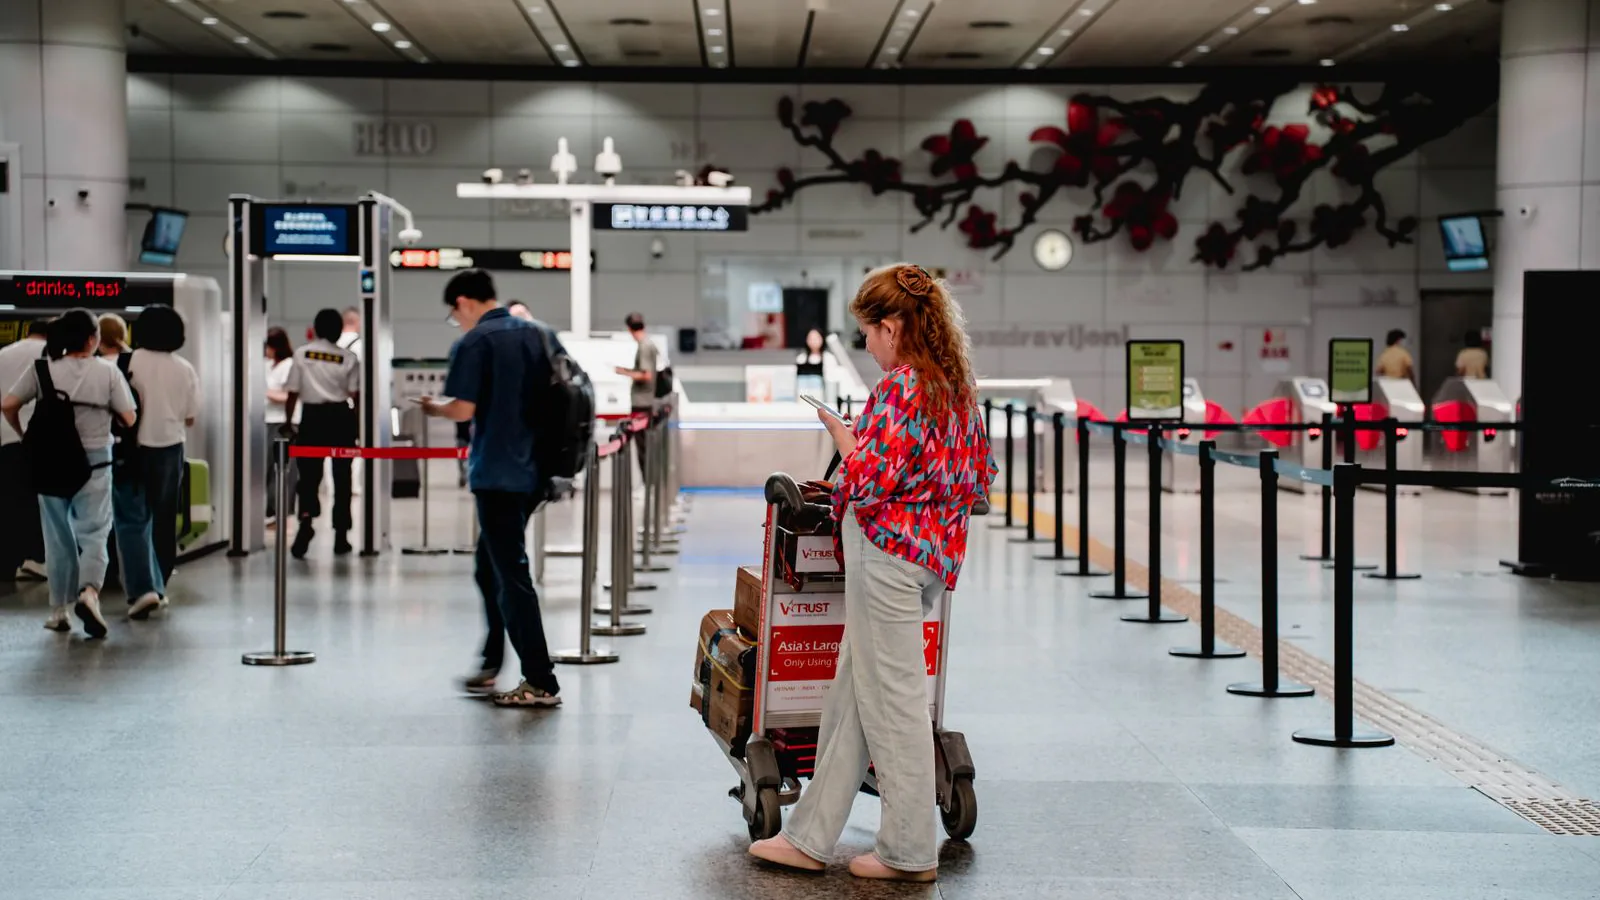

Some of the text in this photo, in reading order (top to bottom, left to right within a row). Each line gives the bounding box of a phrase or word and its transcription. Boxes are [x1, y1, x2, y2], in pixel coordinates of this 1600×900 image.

[354, 122, 437, 156] HELLO
[26, 280, 81, 298] drinks,
[777, 641, 811, 652] Asia's
[783, 659, 805, 668] Only
[807, 658, 832, 668] Using
